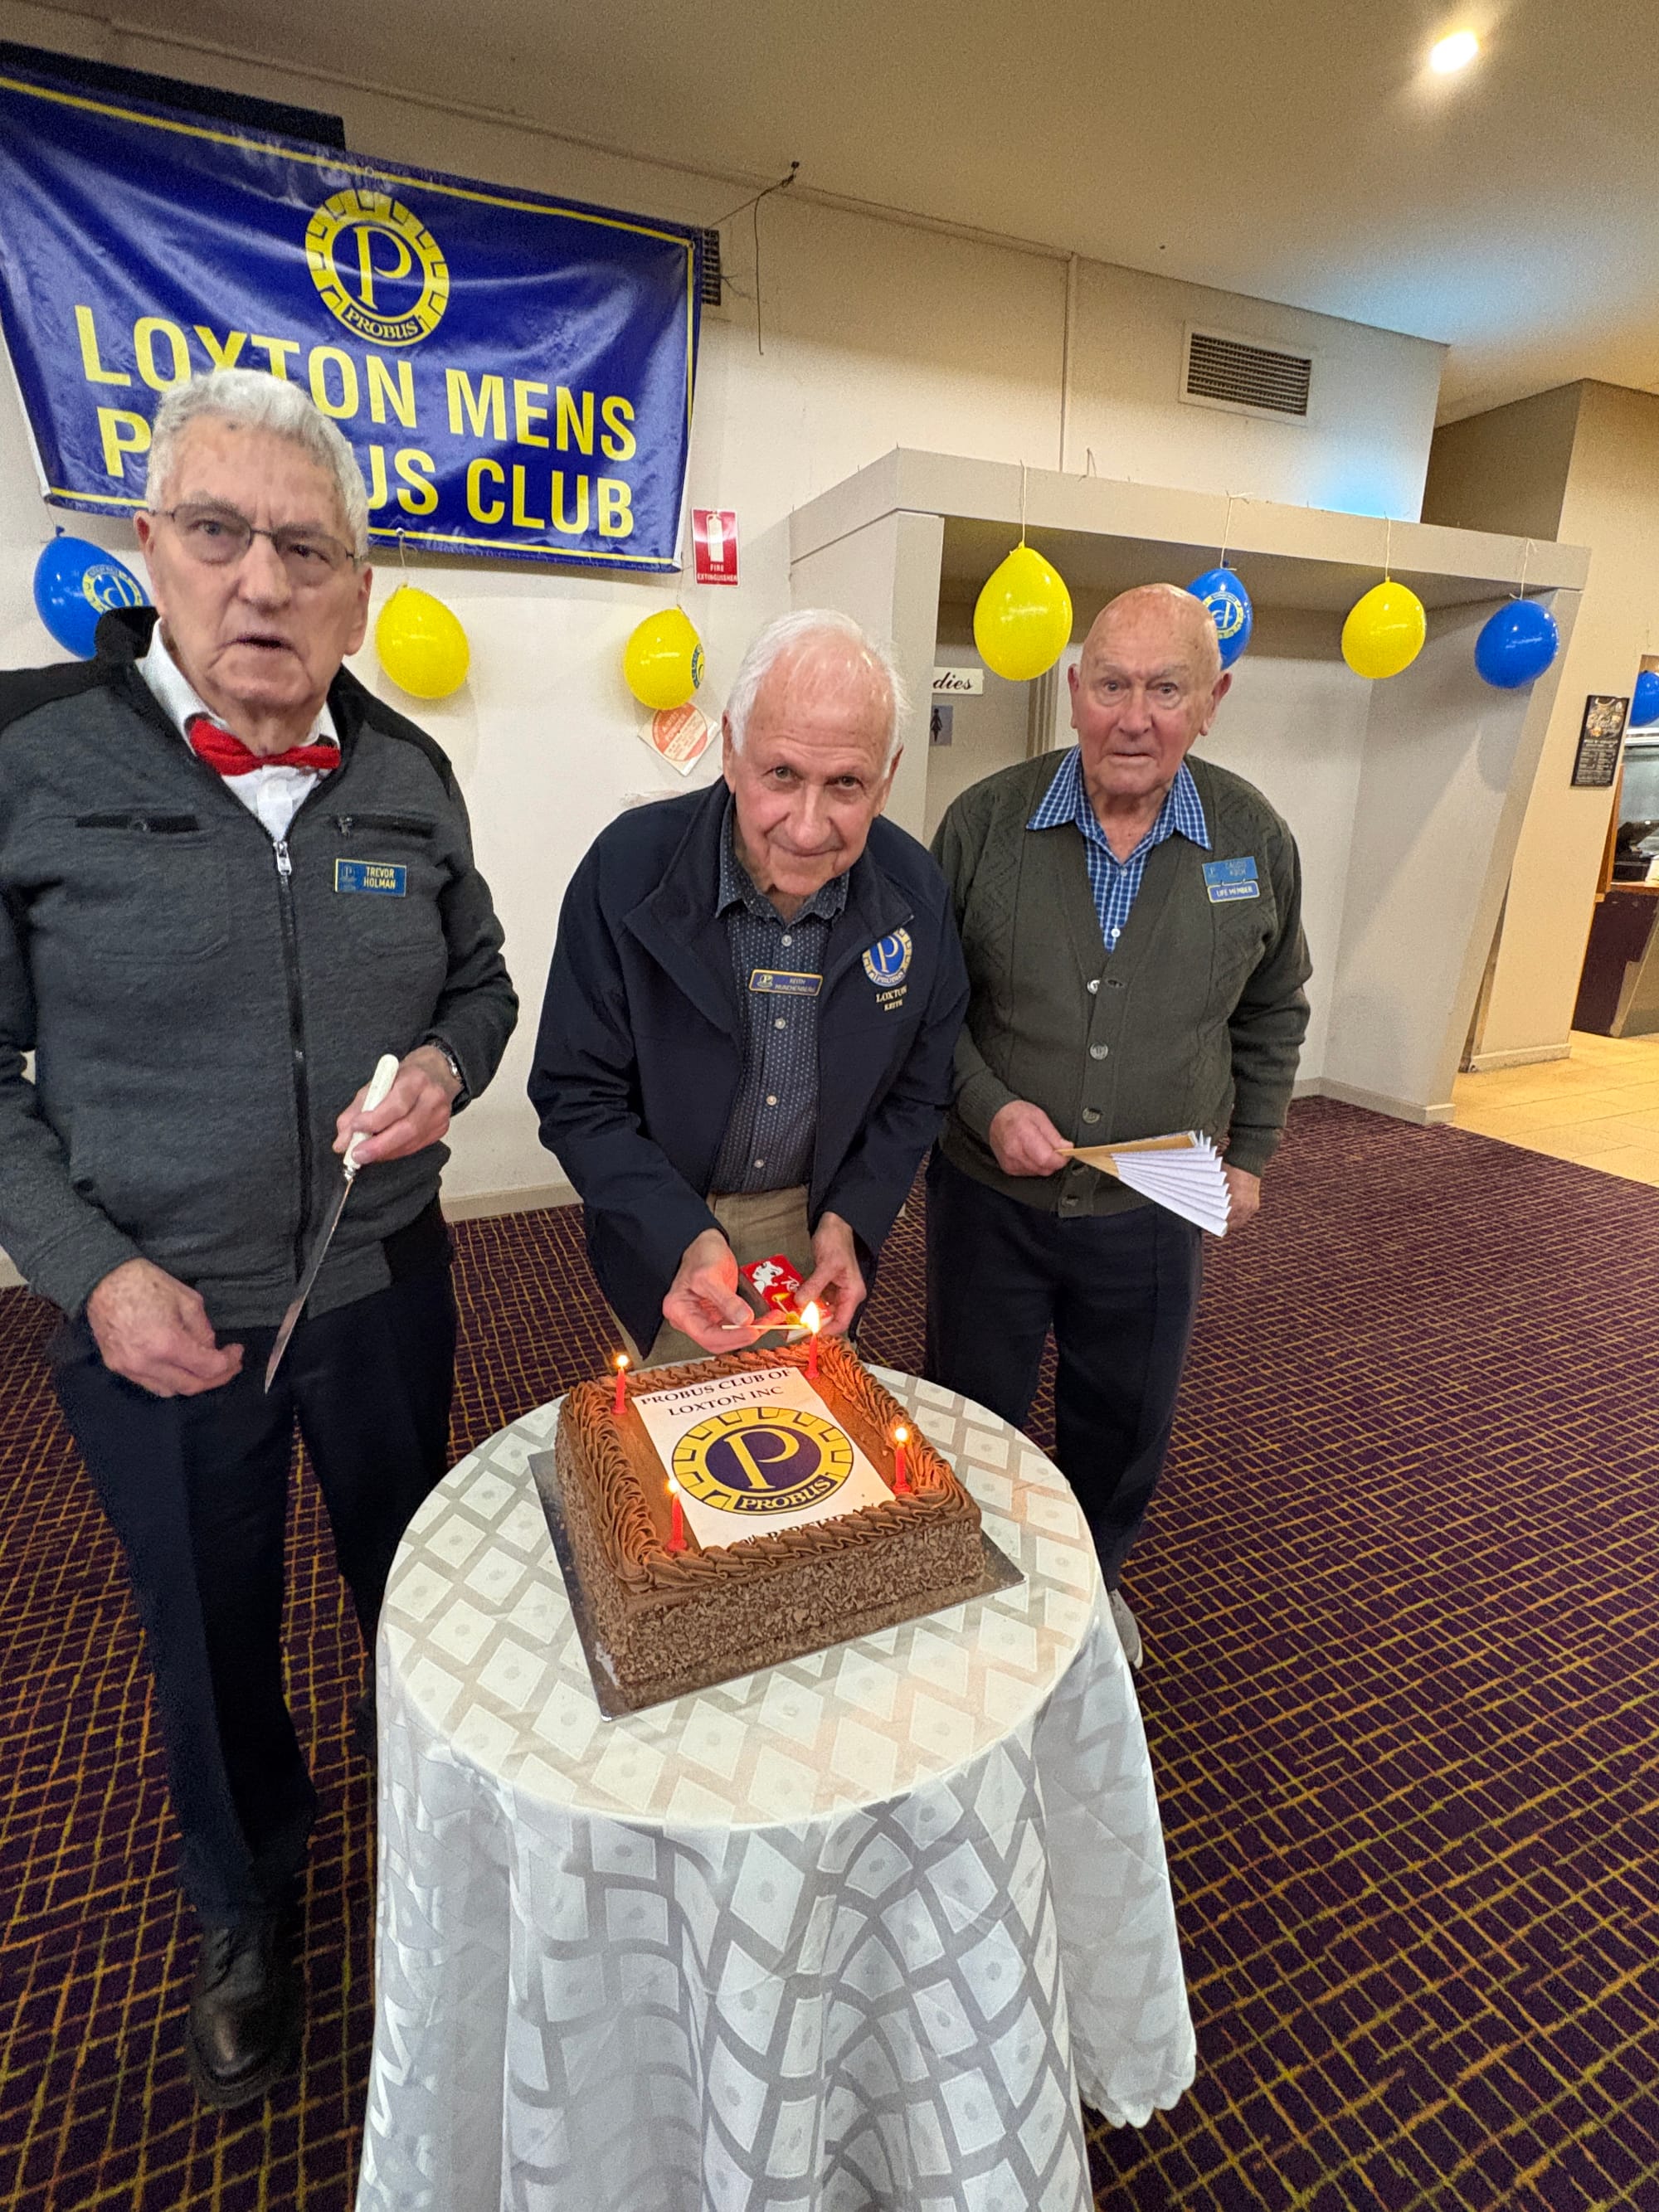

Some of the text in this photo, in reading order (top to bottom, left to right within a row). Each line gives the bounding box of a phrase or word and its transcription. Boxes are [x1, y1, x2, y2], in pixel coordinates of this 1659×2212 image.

[353, 225, 412, 310] P
[344, 308, 419, 340] PROBUS
[445, 368, 636, 461] MENS
[96, 406, 634, 537] PUS CLUB
[710, 563, 724, 571] FIRE
[932, 672, 972, 690] dies
[363, 876, 396, 889] HOLMAN
[366, 866, 395, 878] TREVOR
[641, 1385, 715, 1405] PROBUS
[718, 1373, 765, 1390] CLUB
[668, 1386, 785, 1416] LOXTON INC
[723, 1427, 800, 1490] P
[738, 1477, 833, 1511] PROBUS
